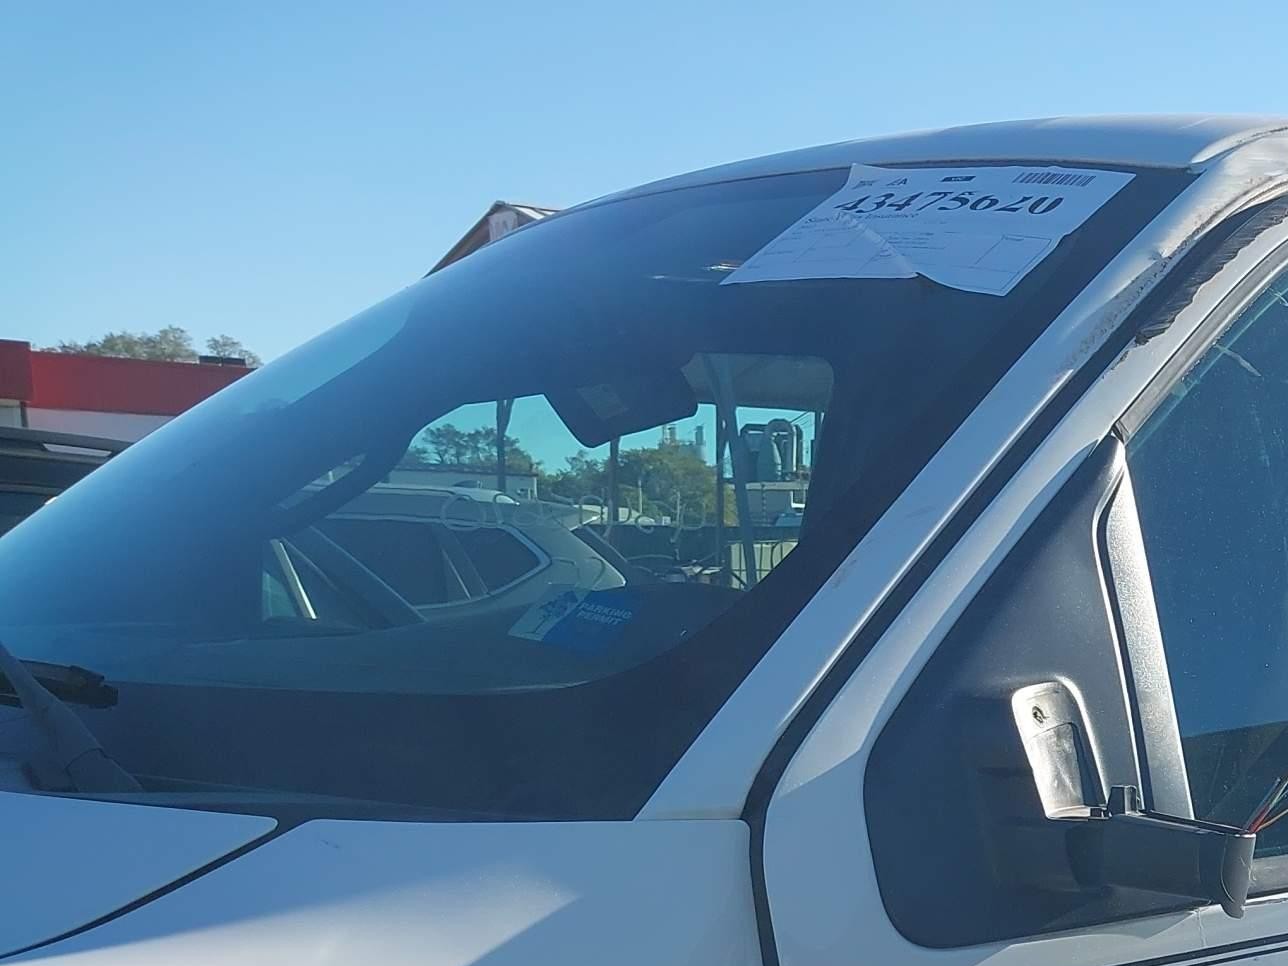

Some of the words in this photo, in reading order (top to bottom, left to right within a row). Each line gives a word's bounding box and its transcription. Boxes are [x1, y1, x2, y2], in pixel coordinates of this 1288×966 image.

[834, 190, 1064, 216] 43475620
[575, 611, 623, 626] PERMIT
[576, 602, 633, 620] PARKING
